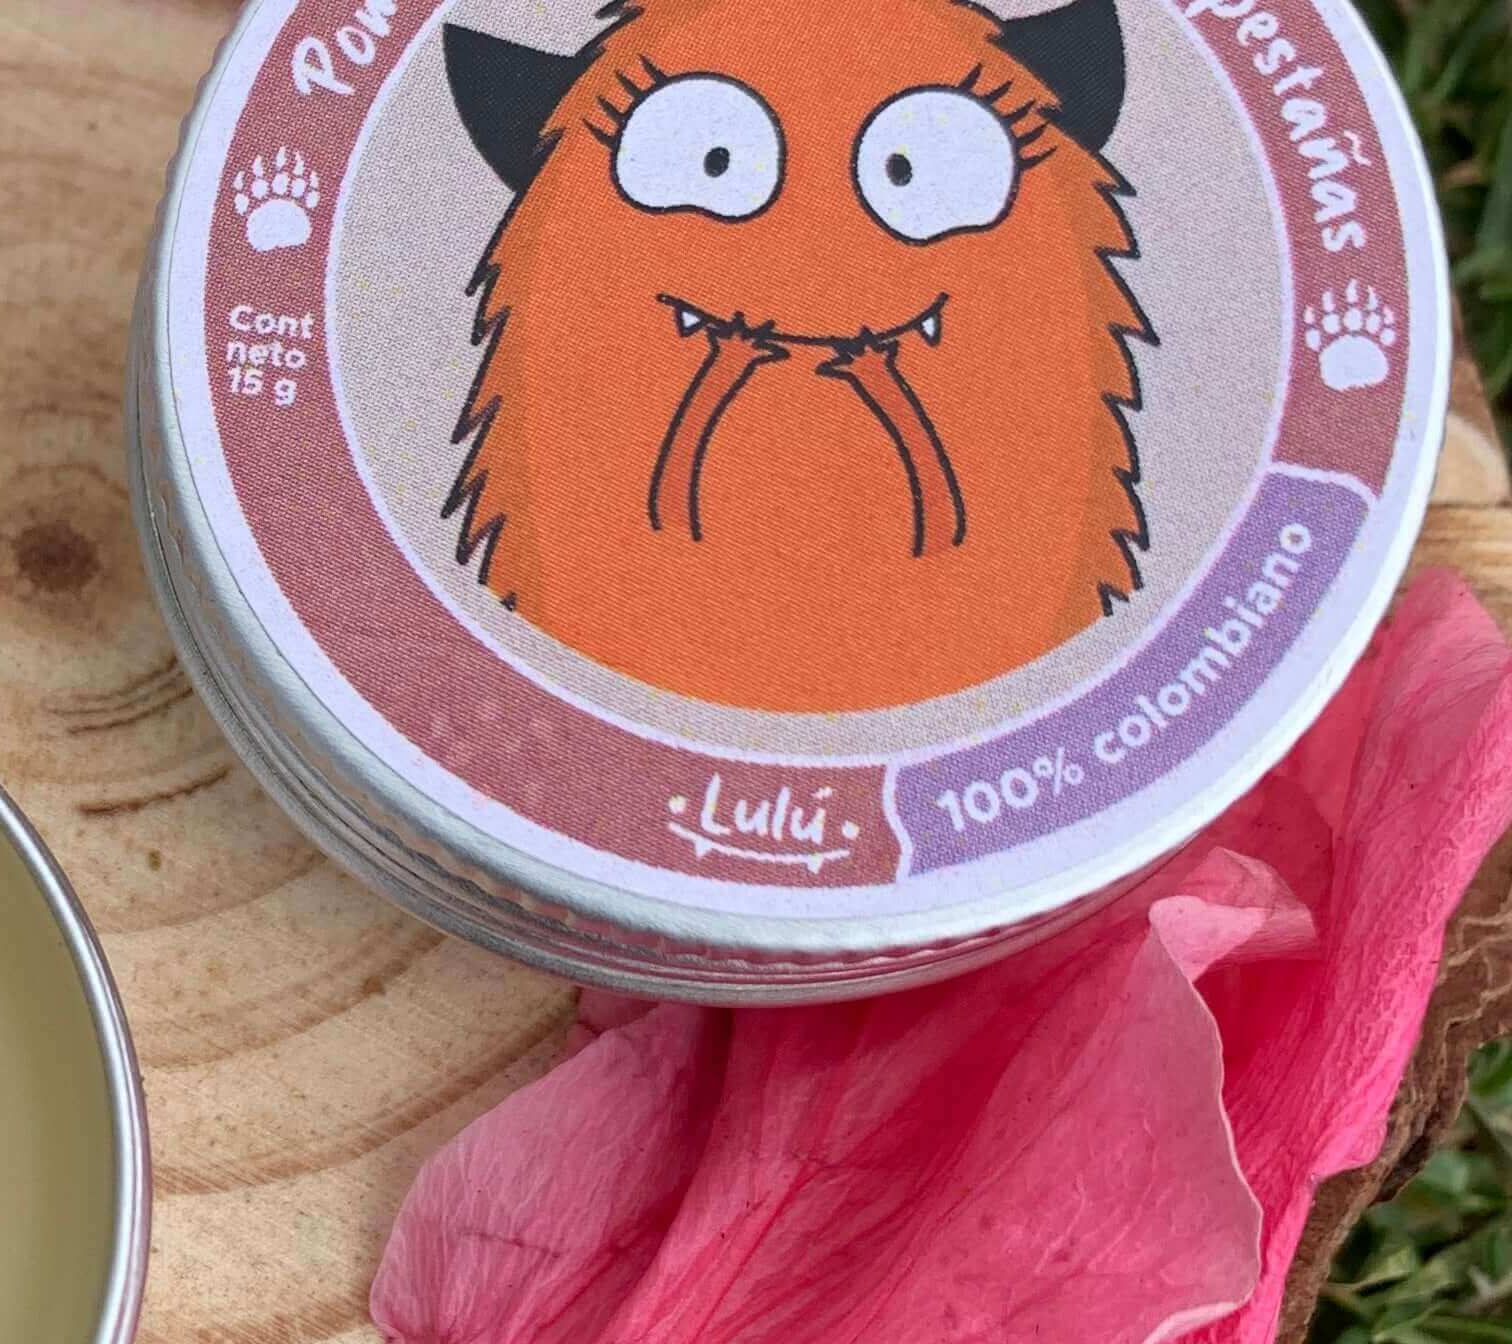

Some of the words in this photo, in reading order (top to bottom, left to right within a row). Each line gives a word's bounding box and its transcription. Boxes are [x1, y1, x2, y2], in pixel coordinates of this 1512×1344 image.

[230, 305, 316, 340] Cont
[228, 340, 307, 370] neto
[230, 368, 265, 398] 15
[274, 377, 298, 406] g
[936, 745, 1084, 830] 100%
[1091, 521, 1314, 765] colombiano
